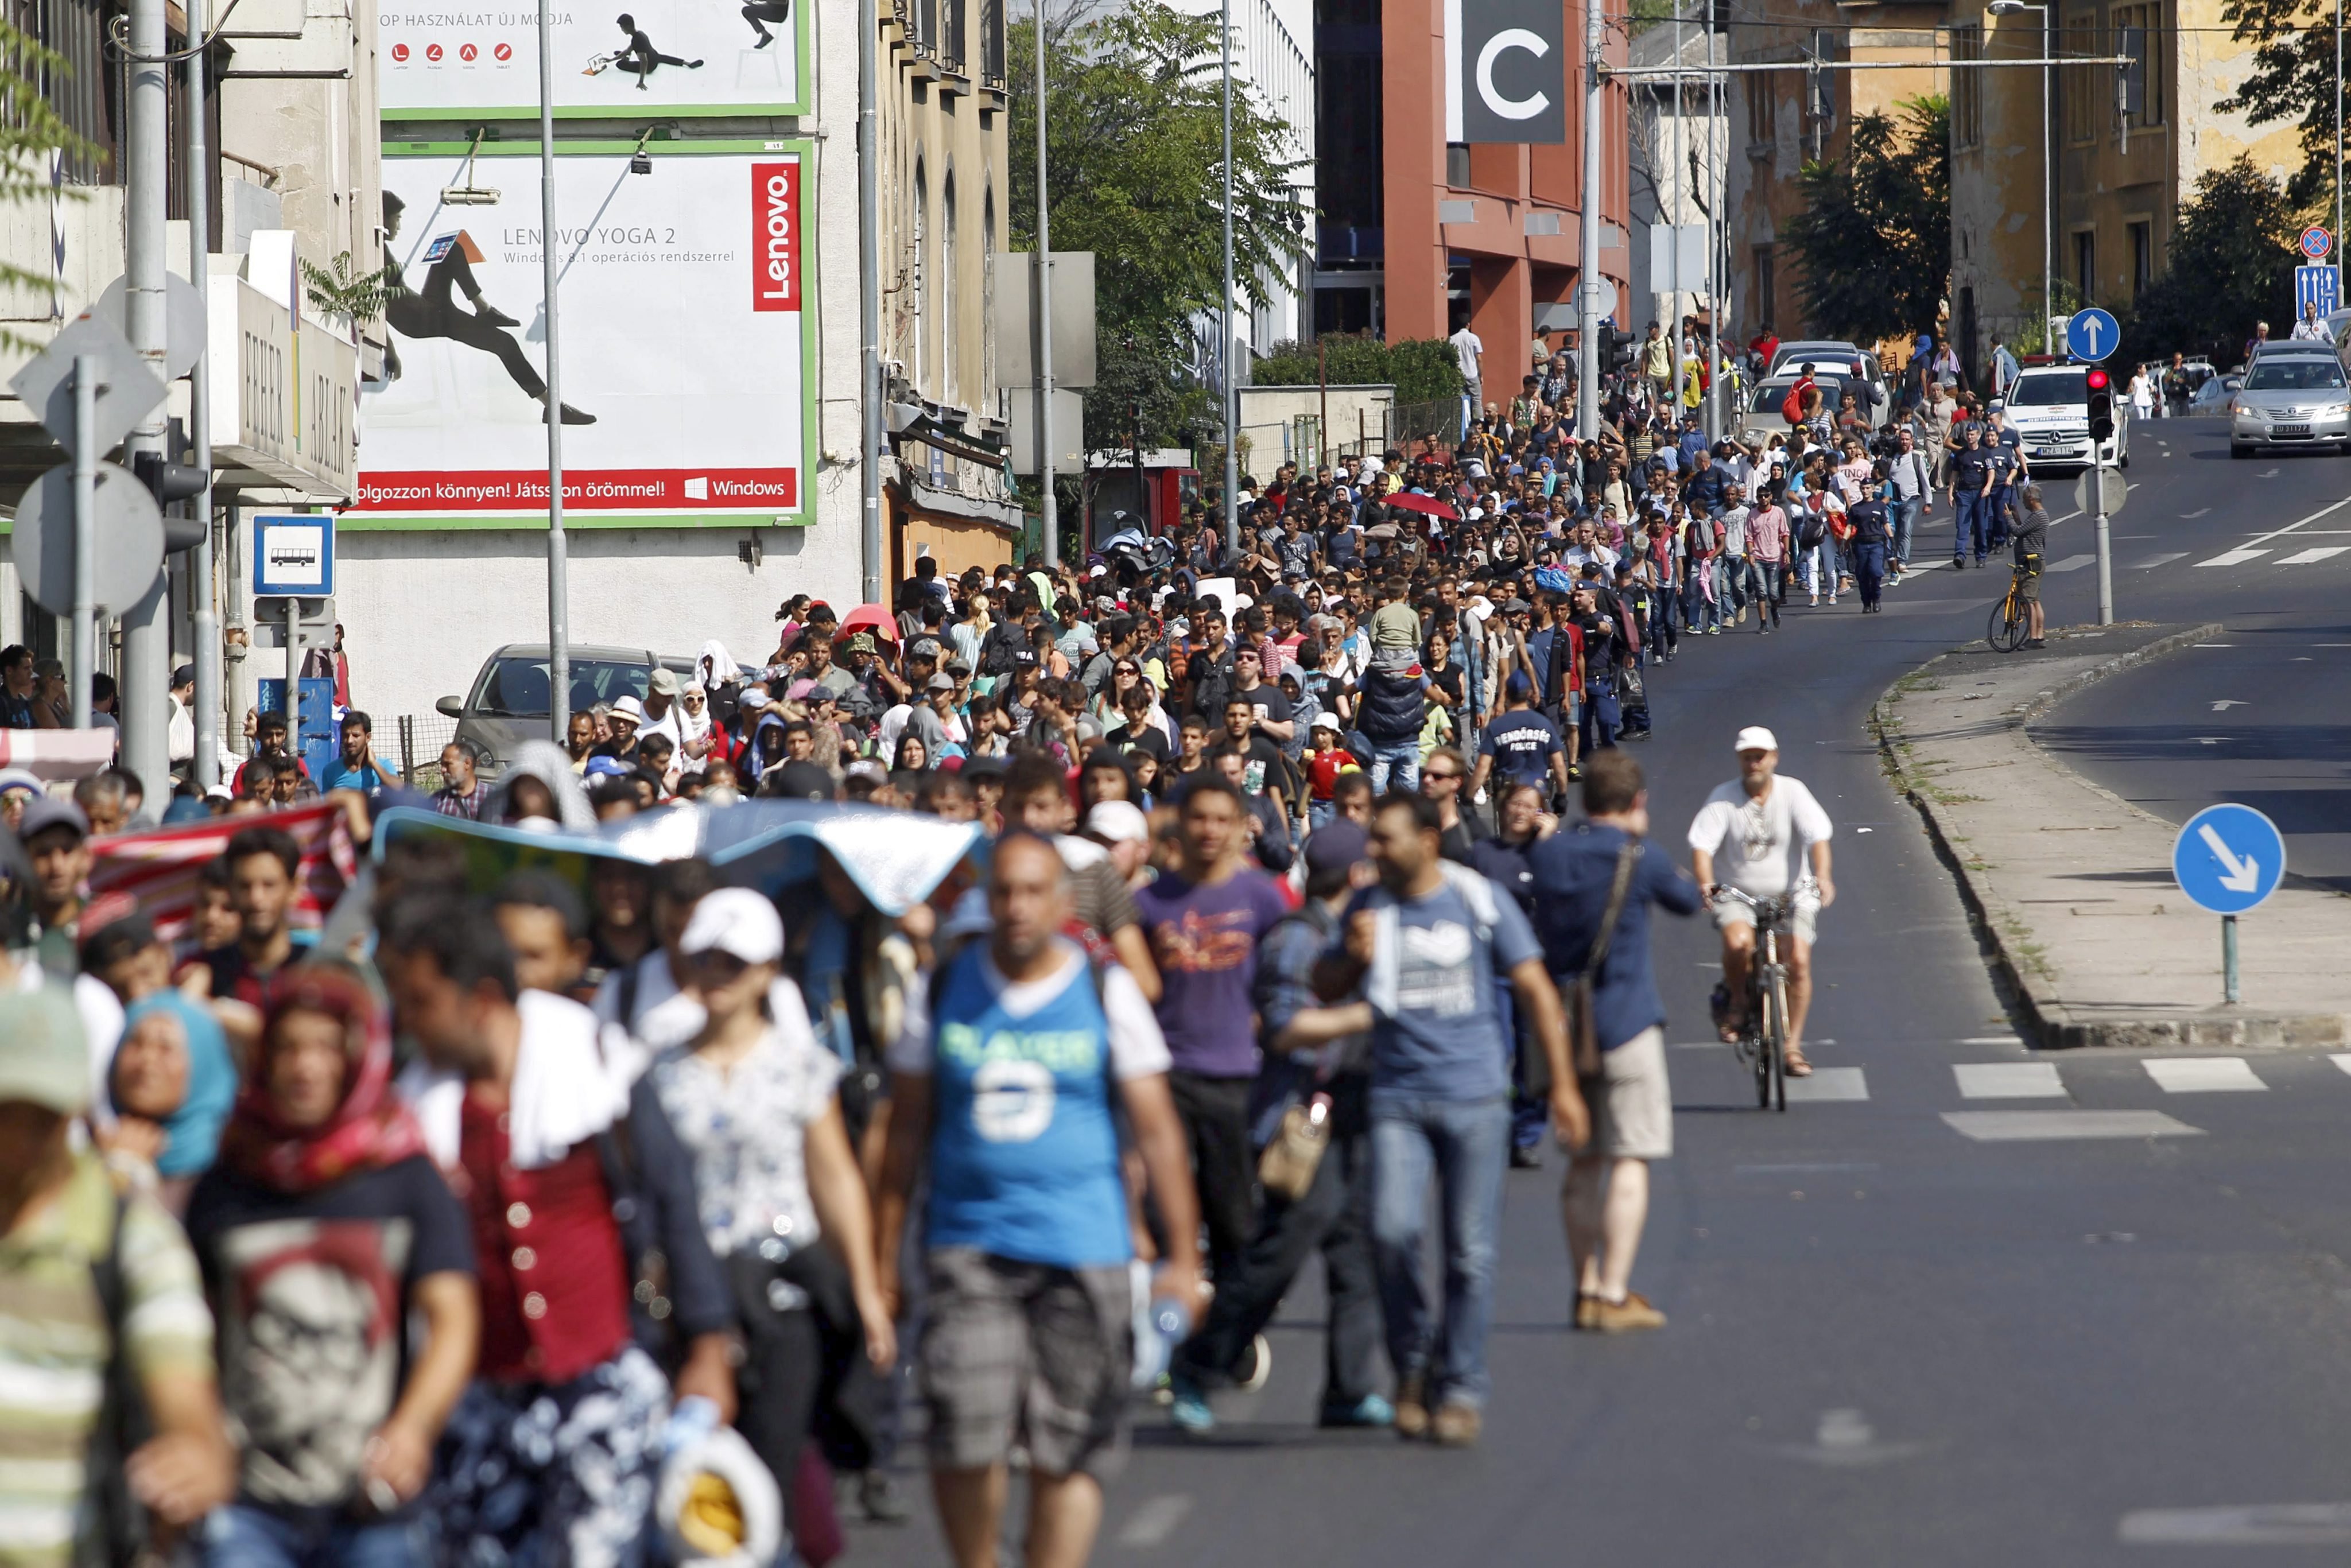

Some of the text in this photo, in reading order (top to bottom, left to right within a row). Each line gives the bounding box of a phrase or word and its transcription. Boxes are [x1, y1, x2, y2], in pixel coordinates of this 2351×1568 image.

[378, 14, 399, 26] OP
[406, 12, 493, 26] HASZNÁLAT
[499, 11, 515, 26] ÚJ
[1476, 28, 1550, 120] C
[504, 227, 676, 245] LENVO YOGA 2
[763, 175, 789, 299] Lenovo
[503, 250, 734, 265] Windos 8.1 operációs rendszerrel
[357, 479, 785, 503] olgozzon könnyen! Játsson örömmel! Windows
[1510, 741, 1537, 752] POLICE
